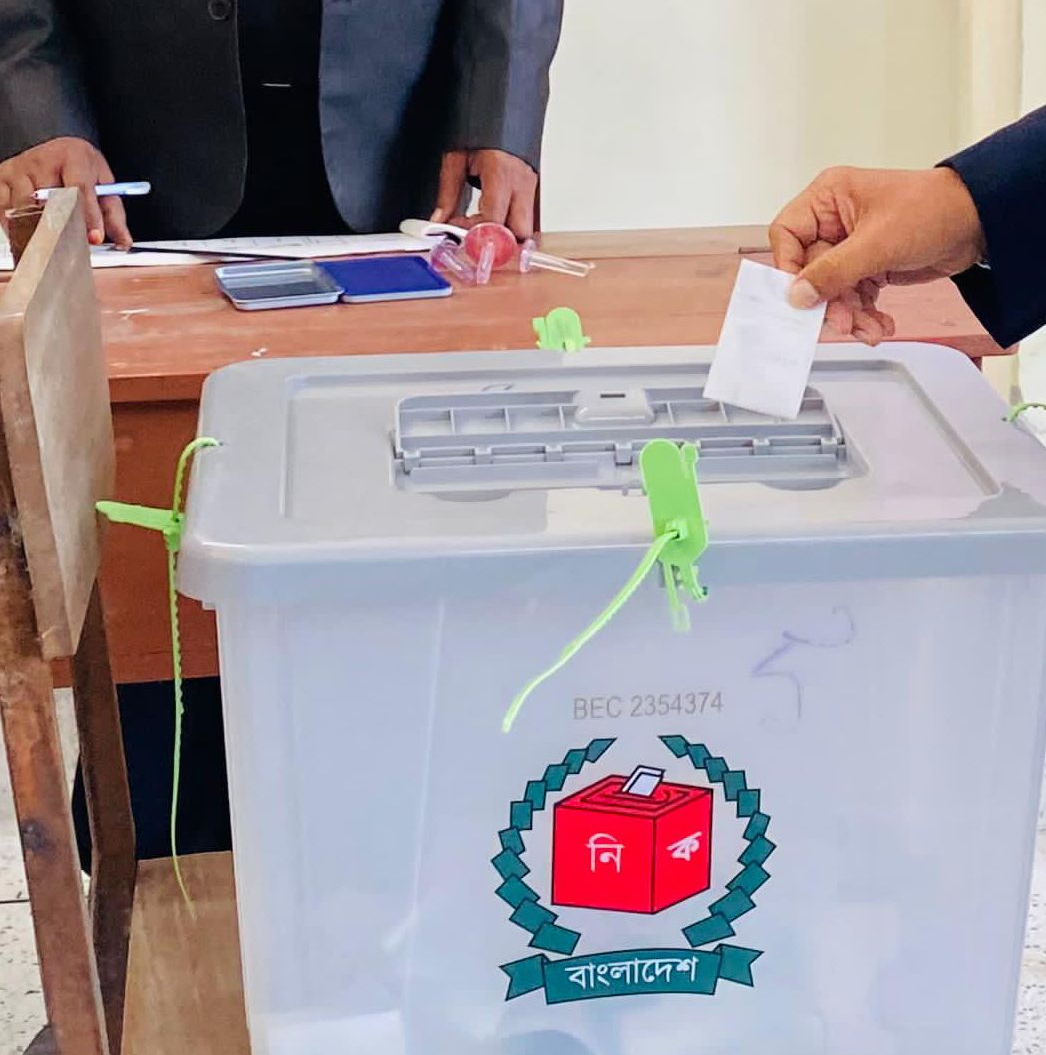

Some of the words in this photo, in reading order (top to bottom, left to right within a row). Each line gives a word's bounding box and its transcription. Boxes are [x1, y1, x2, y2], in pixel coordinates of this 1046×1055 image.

[573, 696, 622, 721] BEC
[630, 690, 725, 718] 2354374
[586, 832, 625, 874] নি
[666, 830, 703, 862] ক
[564, 956, 700, 990] বাংলাদেশ
